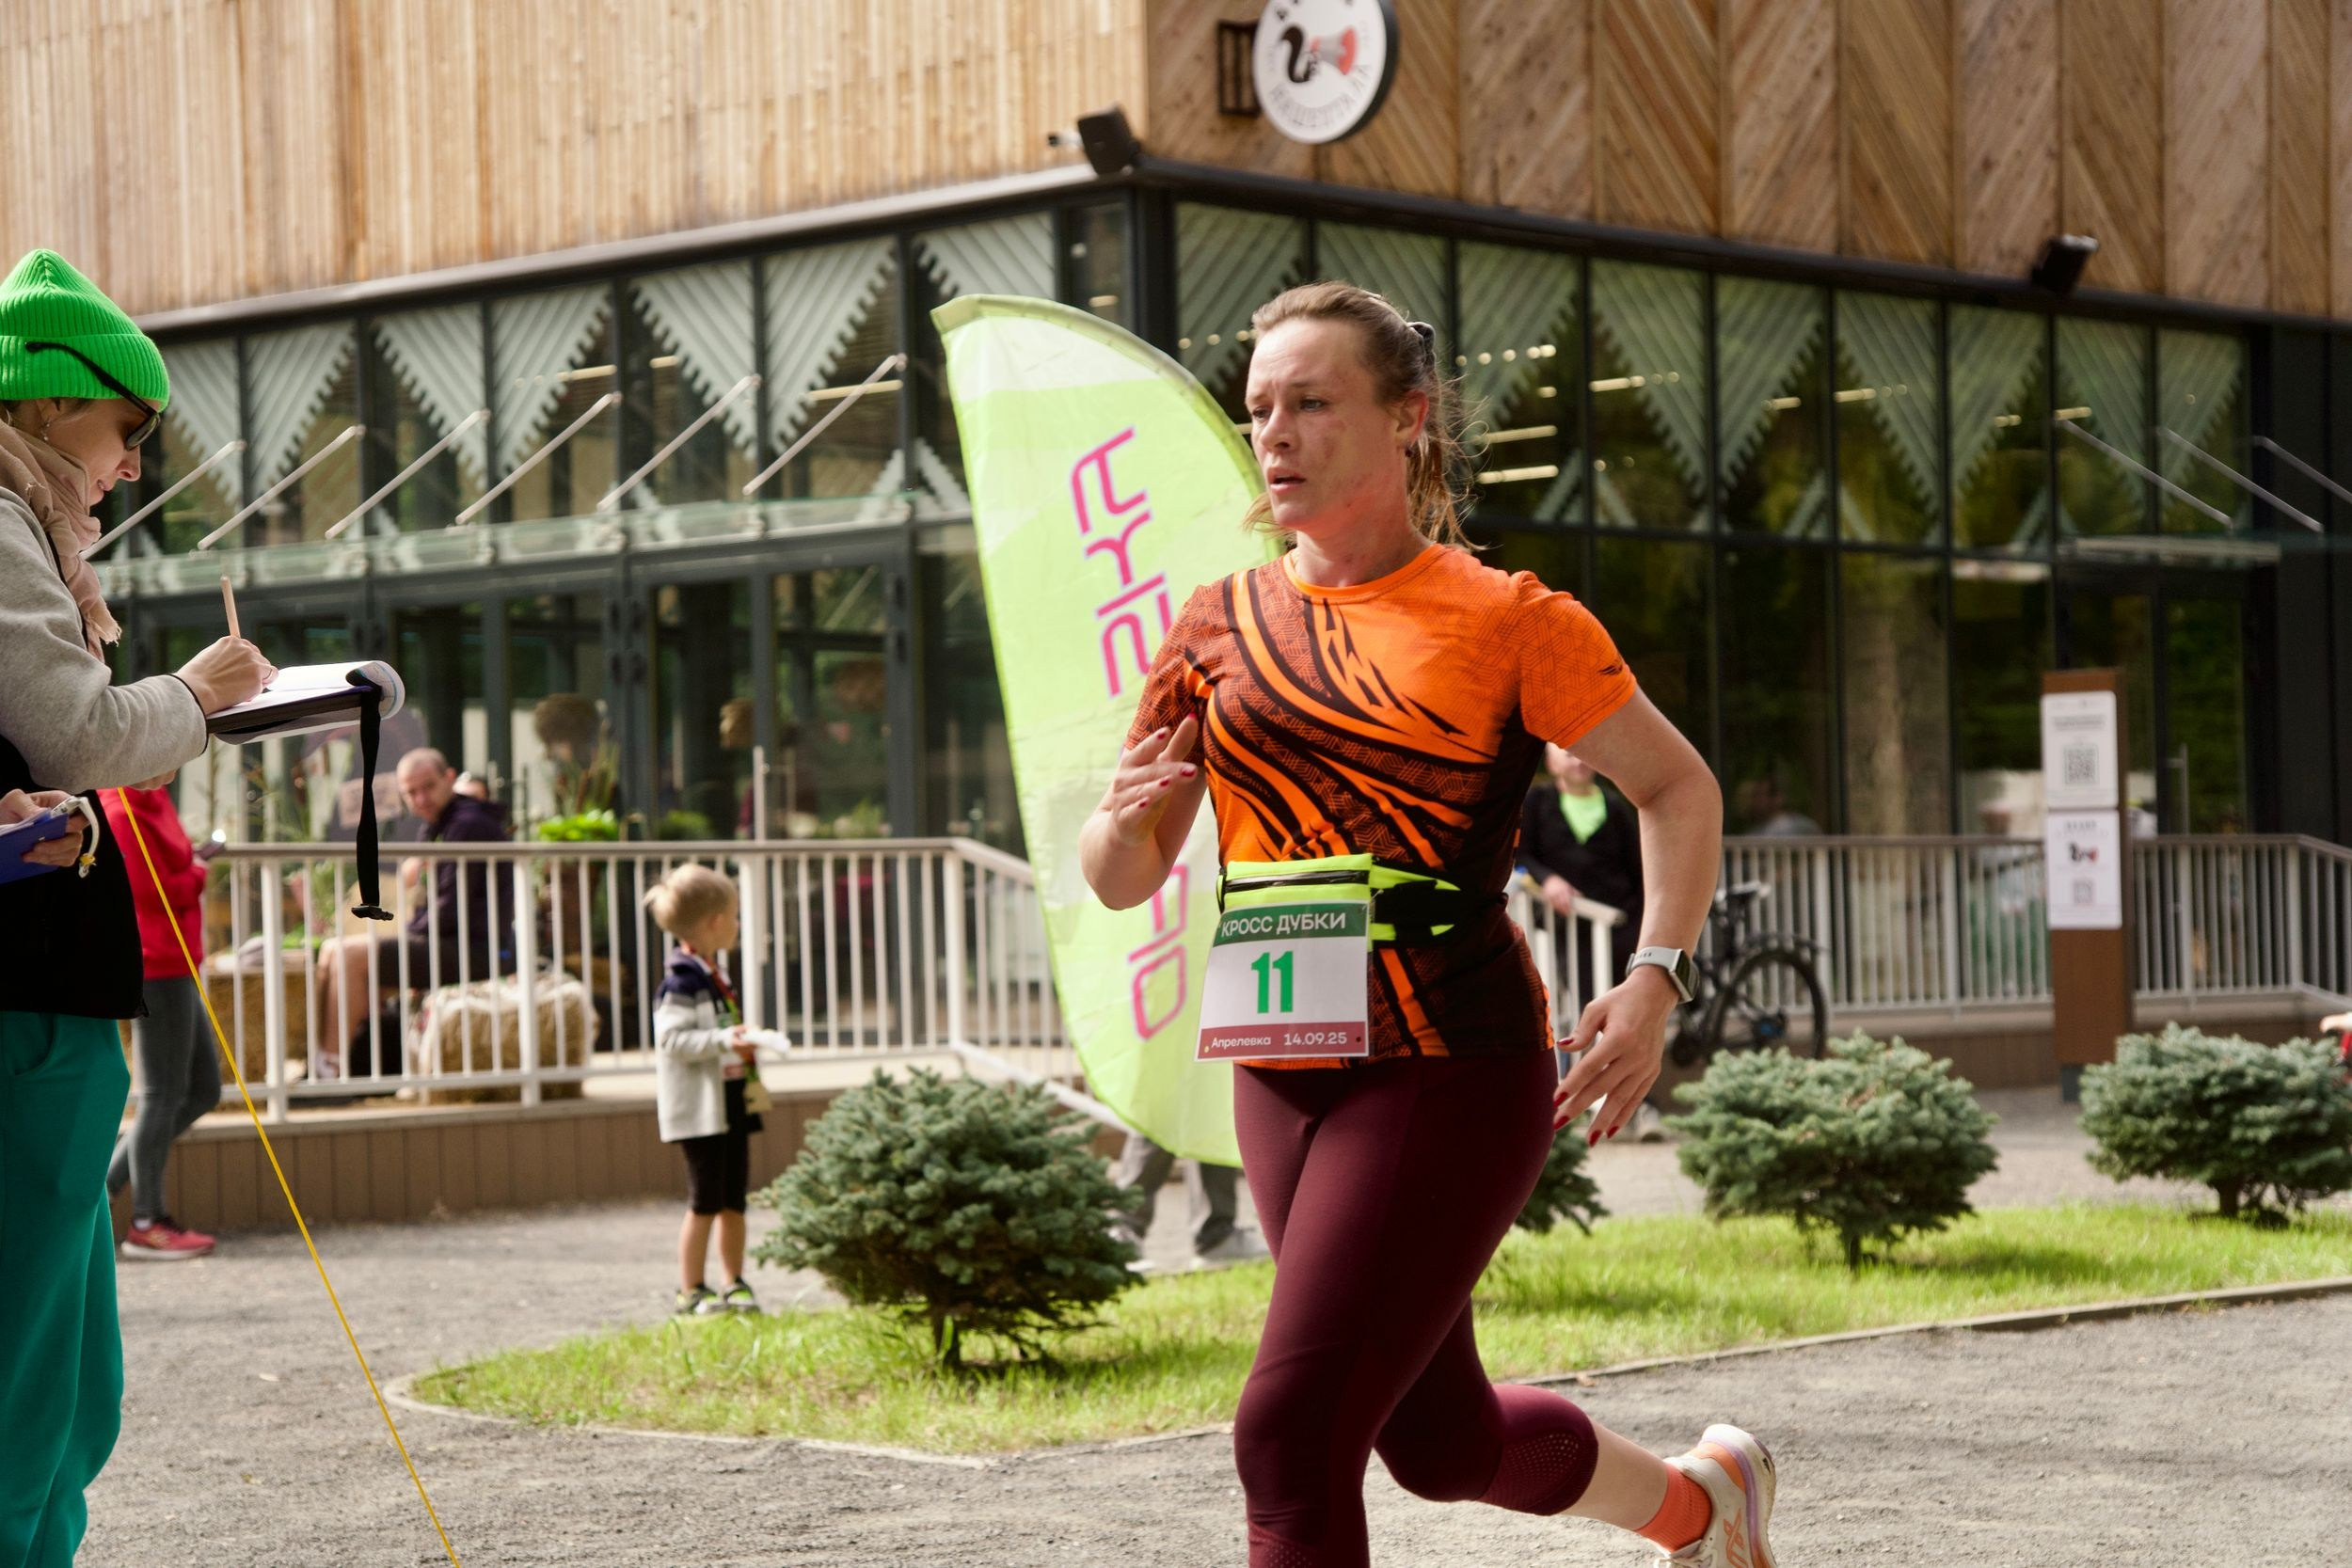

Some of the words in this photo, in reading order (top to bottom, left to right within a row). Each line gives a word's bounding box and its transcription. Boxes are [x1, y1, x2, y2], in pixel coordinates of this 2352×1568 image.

[1221, 915, 1274, 938] КРОСС
[1276, 911, 1347, 936] ДУБКИ
[1250, 950, 1295, 1014] 11
[1211, 1036, 1272, 1051] Апрелевка
[1283, 1031, 1348, 1046] 14.09.25
